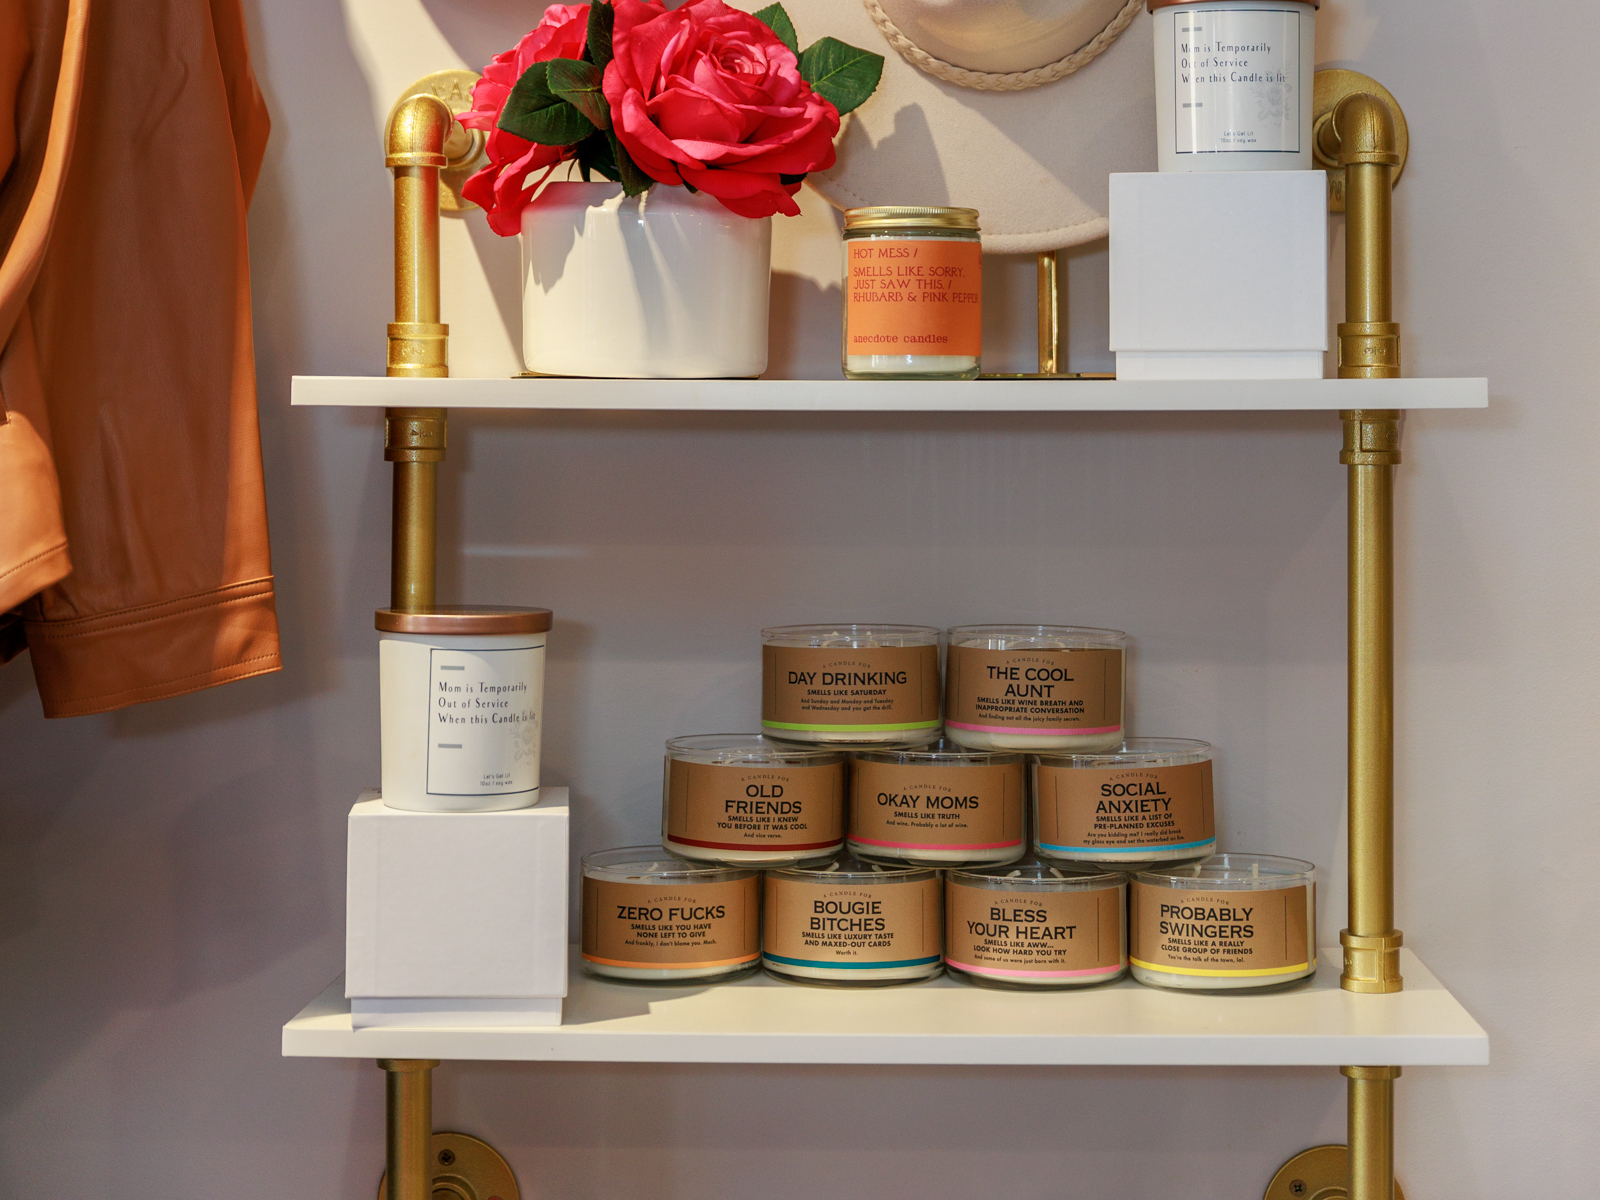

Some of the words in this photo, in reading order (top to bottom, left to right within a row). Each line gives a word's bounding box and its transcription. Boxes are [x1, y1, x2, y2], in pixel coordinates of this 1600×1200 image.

[1204, 44, 1211, 52] is
[1215, 41, 1272, 54] Temporarily
[1200, 58, 1209, 68] of
[1213, 57, 1248, 67] Service
[1182, 73, 1205, 83] Wen
[1209, 73, 1226, 82] this
[1230, 72, 1262, 82] Candle
[1266, 73, 1273, 82] is
[1276, 74, 1286, 83] lit
[854, 248, 874, 258] HOT
[878, 248, 909, 258] MESS
[913, 248, 918, 258] /
[854, 267, 892, 277] SMELLS
[897, 267, 924, 276] LIKE
[854, 279, 876, 290] JUST
[880, 279, 911, 289] SAW
[916, 279, 944, 289] THIS.
[948, 280, 952, 290] /
[854, 292, 903, 302] RHUBARB
[908, 292, 917, 302] &
[923, 292, 949, 303] PINK
[952, 293, 978, 304] PEPPER
[854, 334, 898, 343] anecdote
[904, 335, 948, 343] candles
[788, 671, 817, 685] DAY
[822, 671, 907, 685] DRINKING
[987, 666, 1020, 680] THE
[1025, 668, 1074, 682] COOL
[439, 682, 461, 693] Mom
[466, 683, 473, 693] is
[478, 682, 527, 695] Temporarily
[1004, 684, 1055, 698] AUNT
[438, 697, 456, 708] Out
[462, 698, 471, 708] of
[475, 697, 508, 708] Service
[975, 704, 1028, 713] INAPPROPRIATE
[438, 712, 465, 724] When
[470, 712, 488, 724] this
[492, 712, 520, 723] Candle
[522, 713, 527, 722] is
[746, 785, 783, 798] OLD
[1101, 782, 1166, 797] SOCIAL
[725, 800, 802, 814] FRIENDS
[877, 792, 920, 808] OKAY
[926, 796, 979, 809] MOMS
[1096, 798, 1172, 813] ANXIETY
[894, 811, 918, 819] SMELLS
[937, 812, 960, 820] TRUTH
[1094, 822, 1144, 830] PRE-PLANNED
[617, 905, 663, 921] ZERO
[669, 905, 725, 921] FUCKS
[814, 900, 882, 914] BOUGIE
[1160, 904, 1253, 921] PROBABLY
[990, 907, 1047, 922] BLESS
[810, 917, 885, 931] BITCHES
[967, 921, 1009, 938] YOUR
[1016, 925, 1076, 939] HEART
[1160, 921, 1254, 938] SWINGERS
[984, 939, 1008, 947] SMELLS
[1168, 937, 1191, 946] SMELLS
[974, 945, 991, 953] LOOK
[993, 947, 1011, 955] HOW
[1012, 948, 1033, 956] HARD
[1161, 944, 1180, 952] CLOSE
[1182, 946, 1208, 954] GROUP
